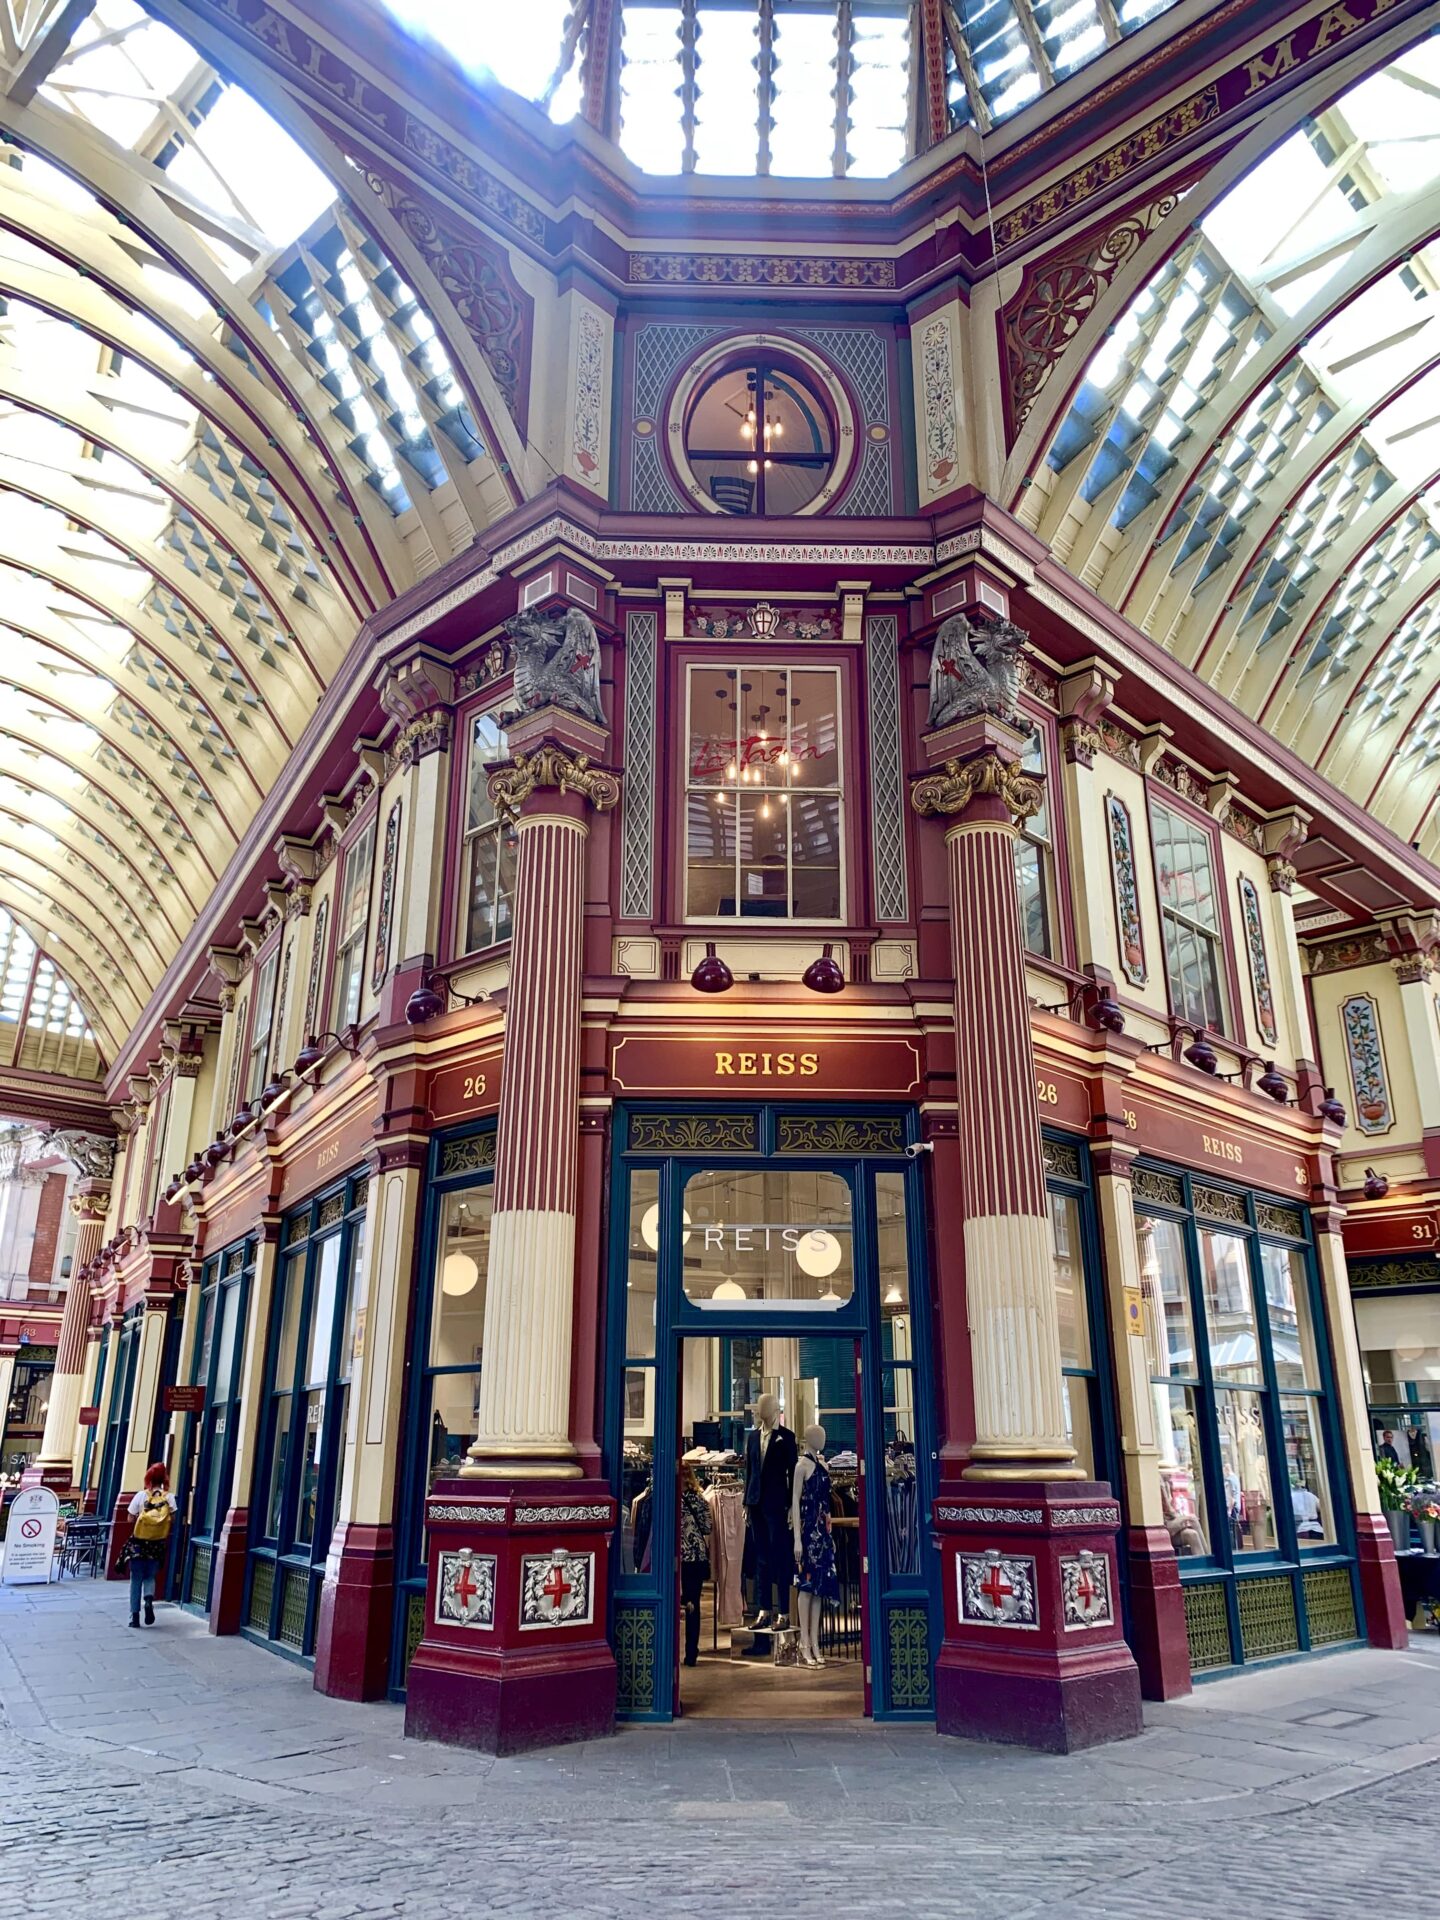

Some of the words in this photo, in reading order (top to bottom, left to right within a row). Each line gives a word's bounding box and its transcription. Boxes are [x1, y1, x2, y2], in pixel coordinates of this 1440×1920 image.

[1243, 0, 1397, 96] MA
[715, 1052, 820, 1076] REISS
[463, 1074, 487, 1099] 26
[1037, 1080, 1058, 1105] 26
[1202, 1134, 1243, 1164] REISS
[705, 1228, 828, 1252] REISS
[1411, 1224, 1432, 1239] 31
